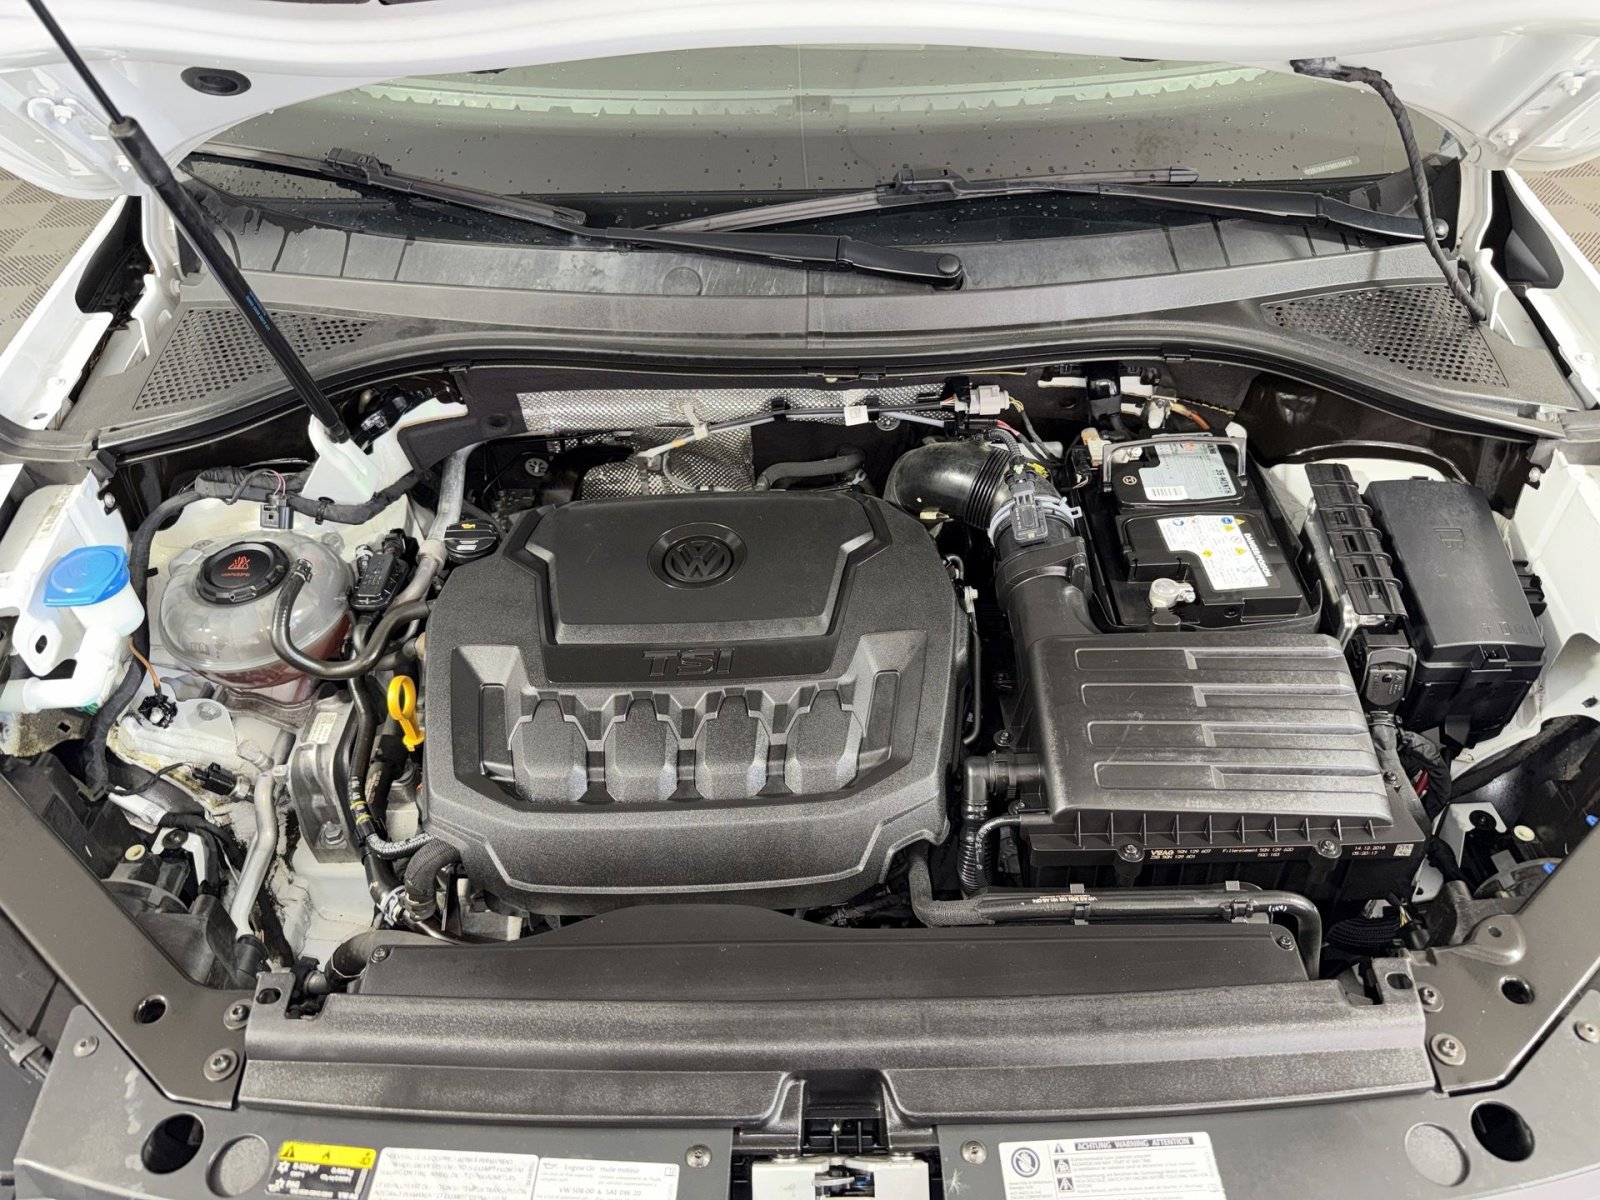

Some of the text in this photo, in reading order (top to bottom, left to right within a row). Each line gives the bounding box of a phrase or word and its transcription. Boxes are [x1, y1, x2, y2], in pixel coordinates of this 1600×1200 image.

[642, 647, 735, 677] TSI
[1077, 1138, 1190, 1150] ACHTUNG WARNING ATTENTION
